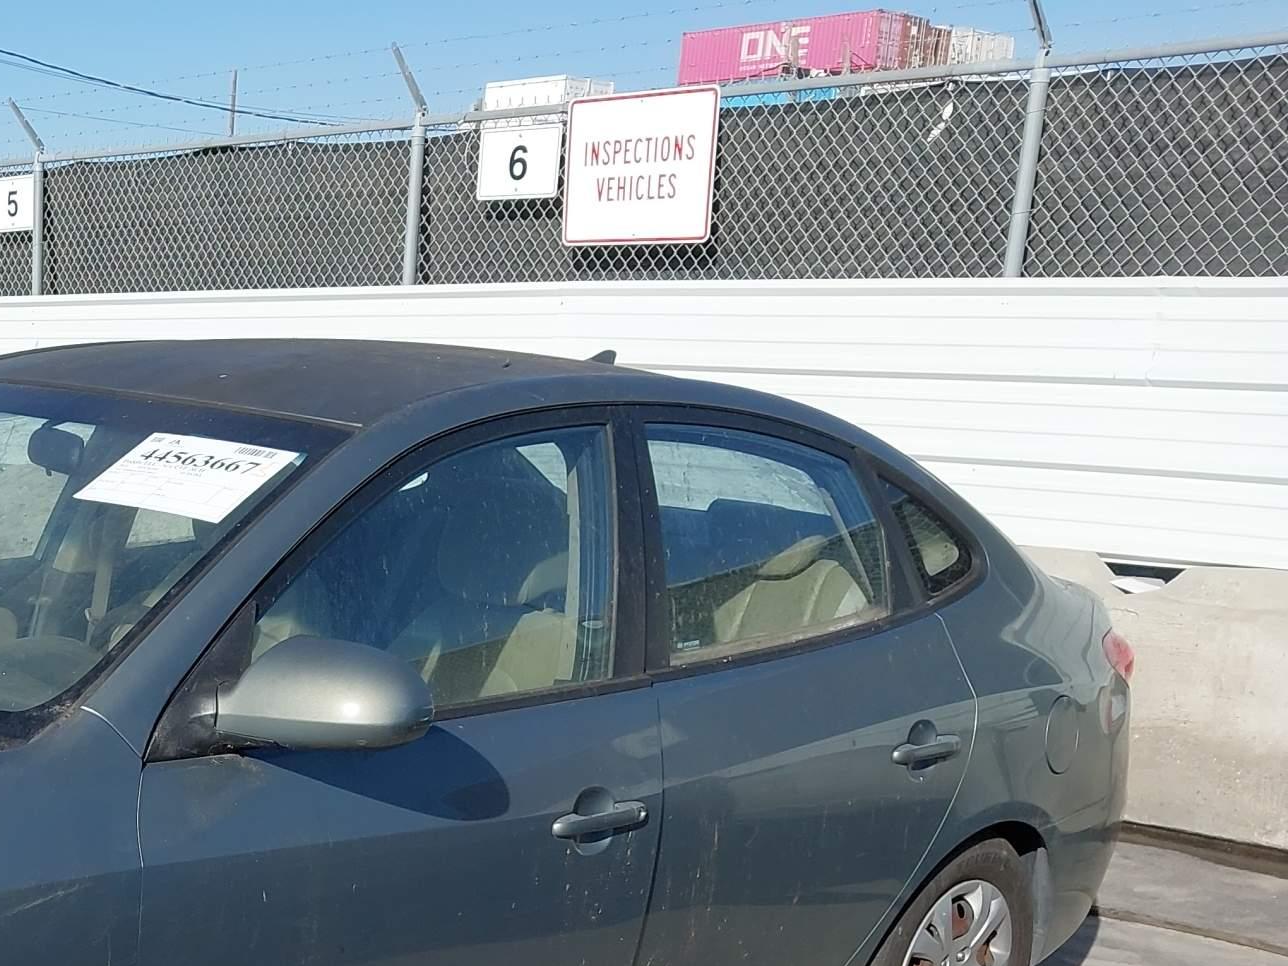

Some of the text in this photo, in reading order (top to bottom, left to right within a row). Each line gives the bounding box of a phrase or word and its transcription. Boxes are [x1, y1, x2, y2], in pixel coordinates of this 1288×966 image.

[740, 25, 811, 64] ONE
[509, 144, 529, 181] 6
[583, 134, 696, 167] INSPECTIONS
[597, 173, 677, 202] VEHICLES
[7, 190, 18, 217] 5
[140, 448, 261, 475] 44563667
